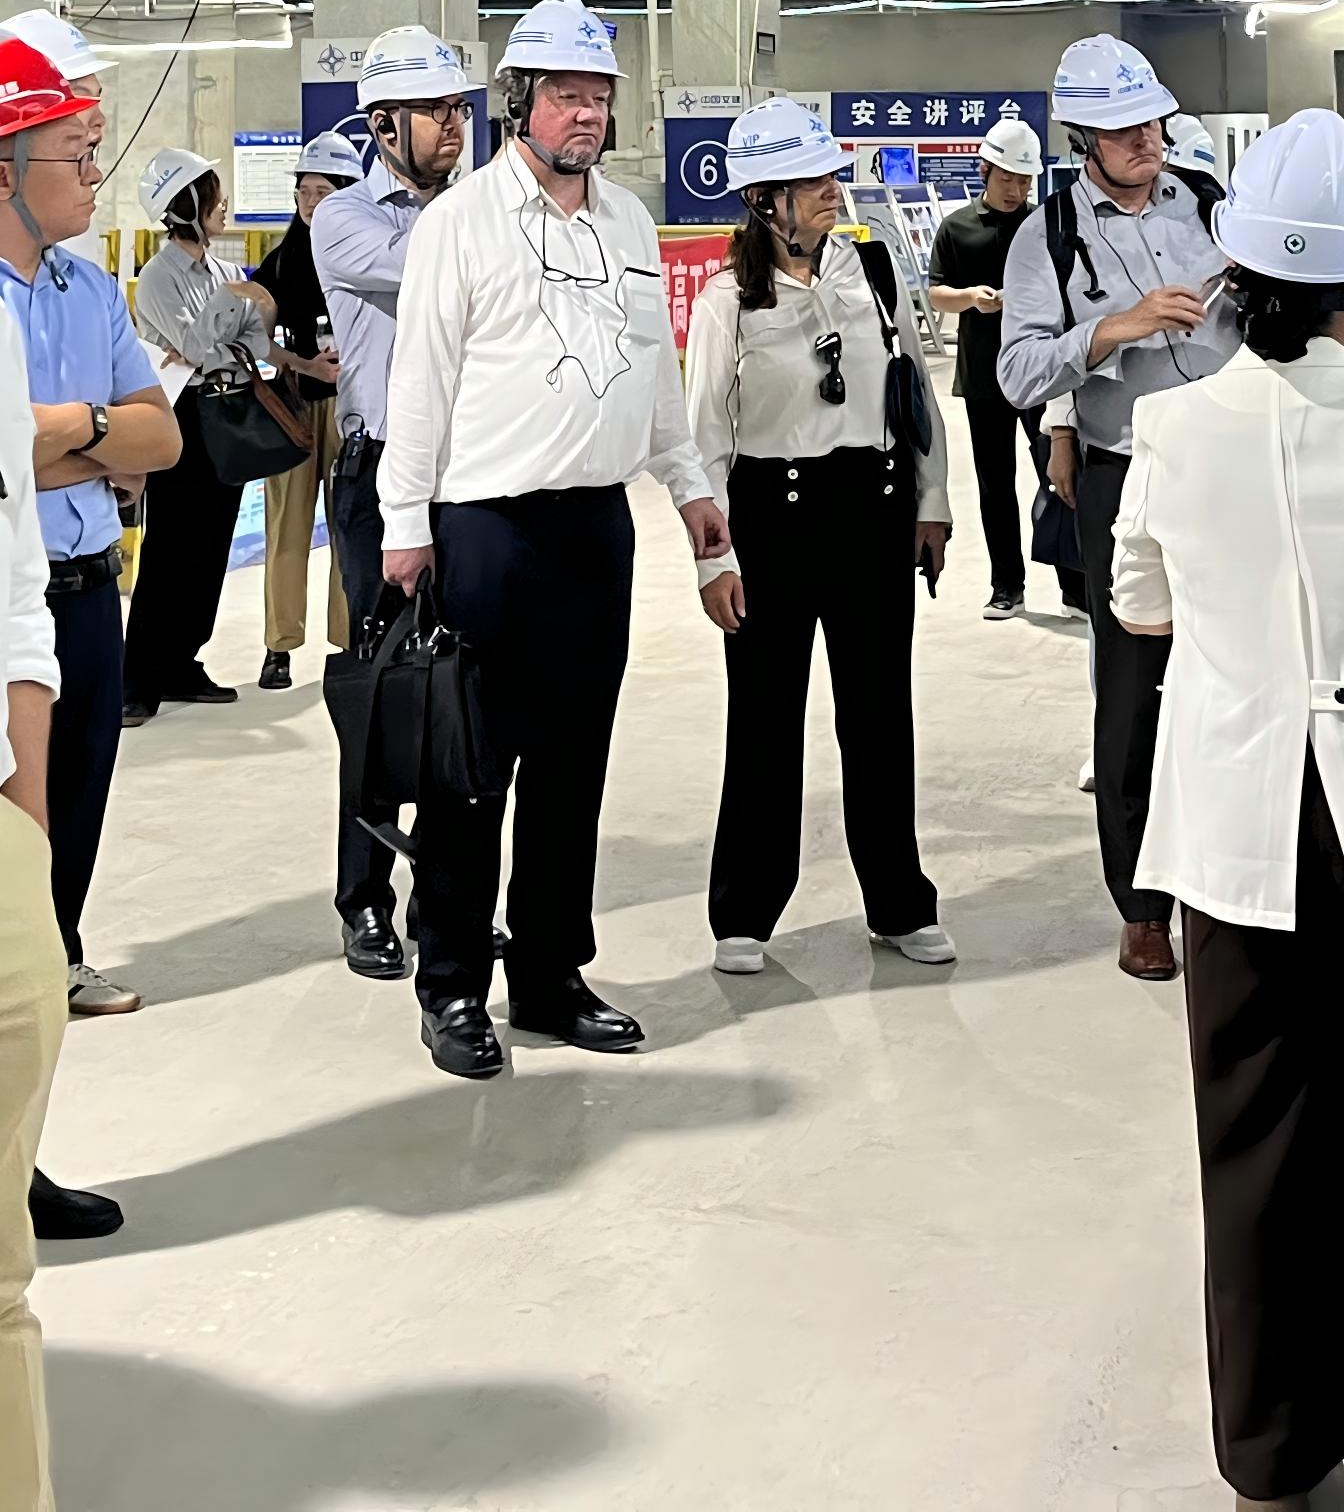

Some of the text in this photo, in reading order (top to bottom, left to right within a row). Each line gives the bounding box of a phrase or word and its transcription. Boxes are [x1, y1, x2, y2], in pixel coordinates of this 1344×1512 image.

[850, 98, 1022, 127] 安全讲评台
[348, 133, 374, 161] 7
[742, 134, 760, 148] VIP
[699, 154, 718, 185] 6
